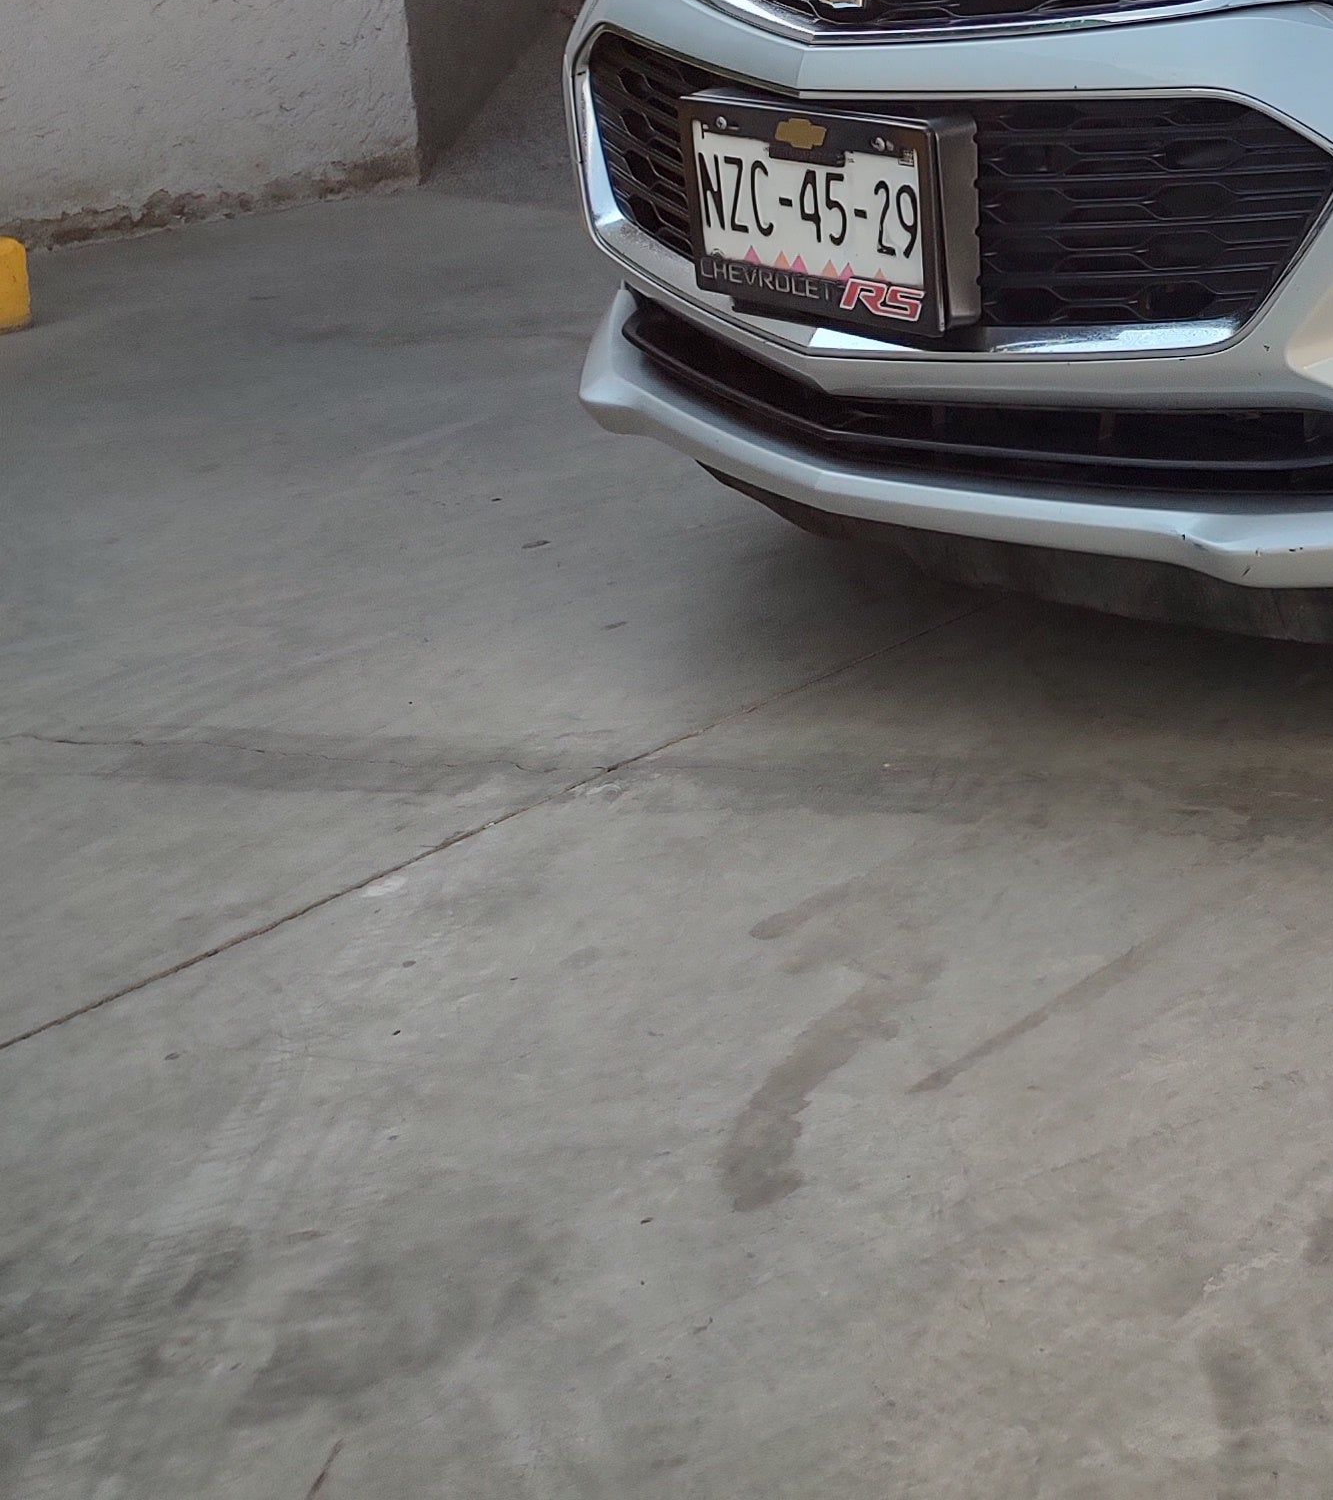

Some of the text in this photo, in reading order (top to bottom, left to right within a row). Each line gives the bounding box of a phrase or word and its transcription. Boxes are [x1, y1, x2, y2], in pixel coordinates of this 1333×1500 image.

[698, 152, 918, 259] NZC-45-29
[700, 257, 925, 321] CHEVROLET RS
